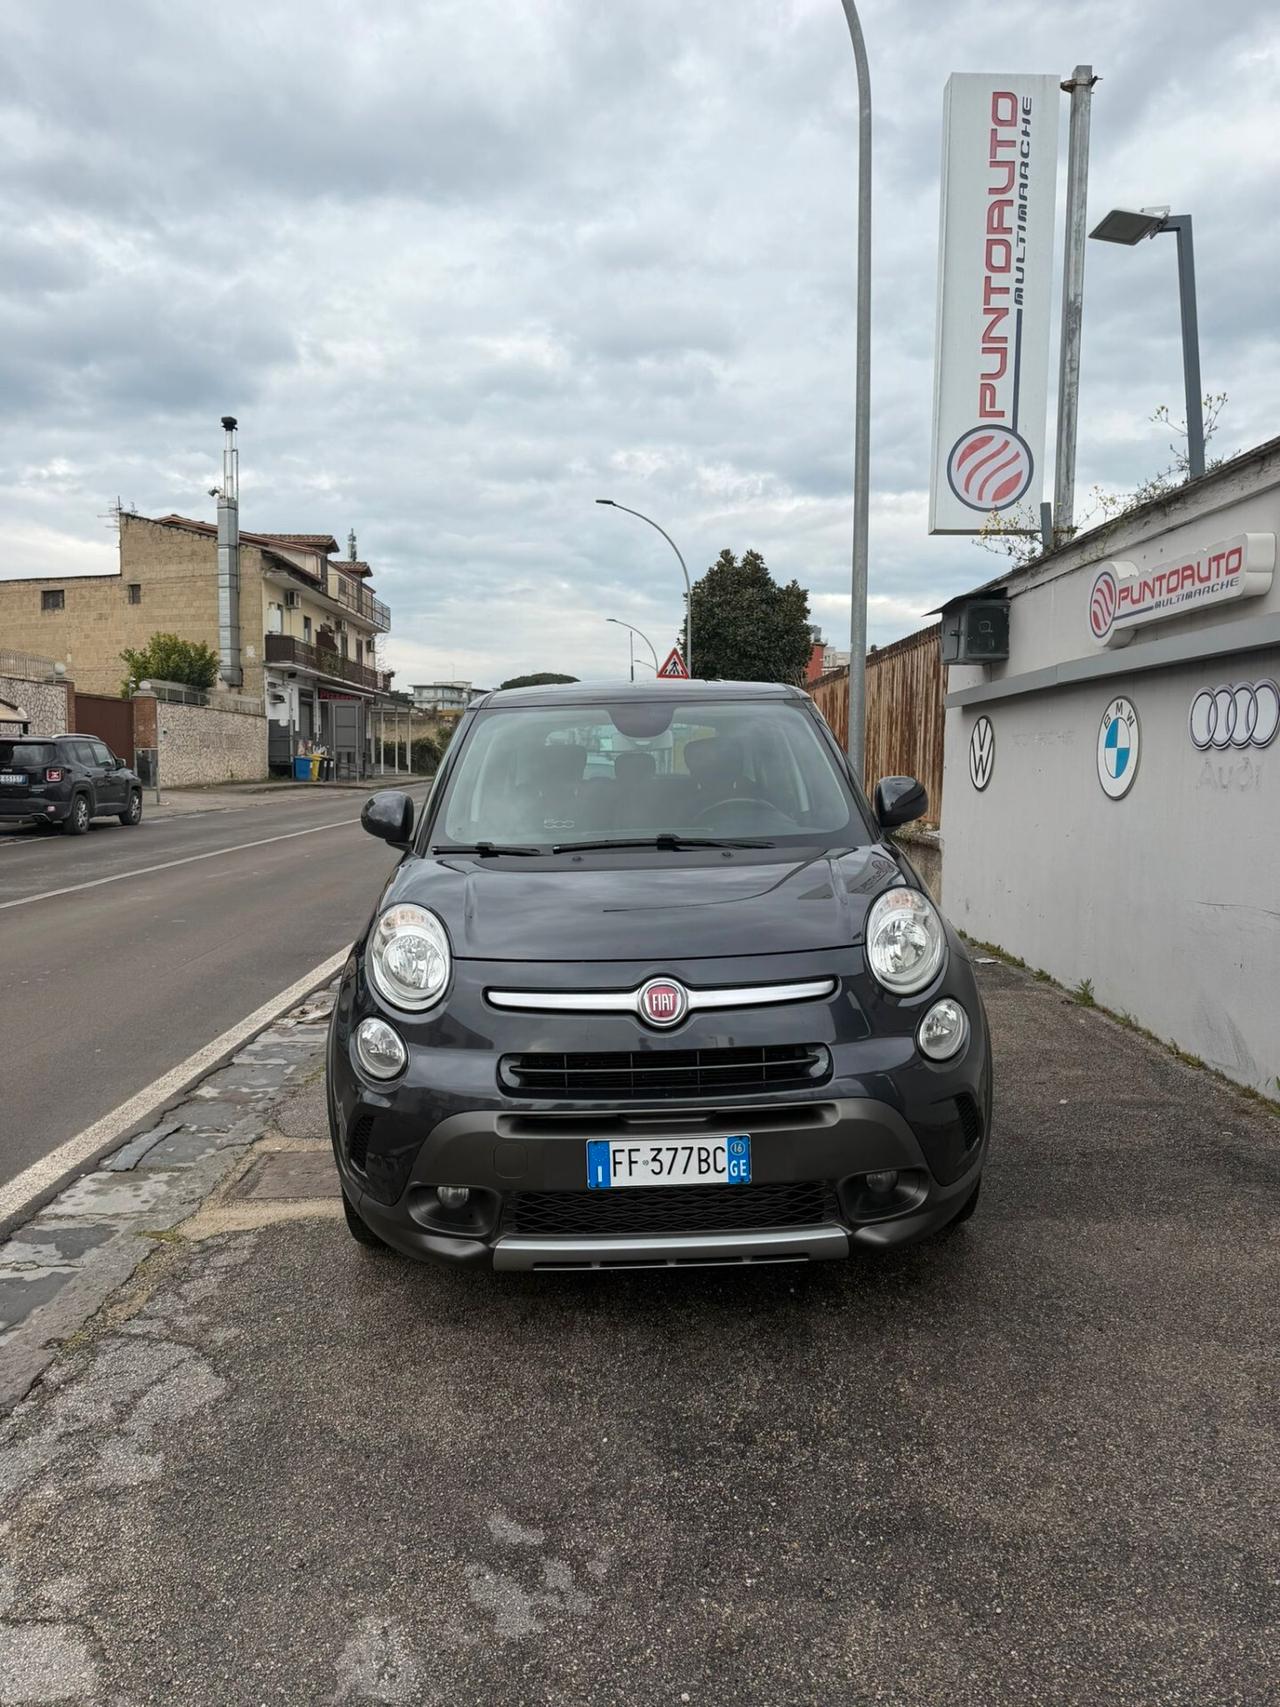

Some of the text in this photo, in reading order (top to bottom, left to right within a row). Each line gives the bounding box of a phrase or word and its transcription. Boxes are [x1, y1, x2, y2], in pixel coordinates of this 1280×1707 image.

[1014, 96, 1032, 305] MULTIMARCHE
[979, 92, 1018, 418] PUNTOAUTO
[1118, 546, 1242, 610] PUNTOAUTO
[1154, 577, 1240, 609] MULTIMARCHE
[1104, 701, 1135, 730] BMW
[652, 993, 675, 1011] FIAT
[733, 1143, 743, 1153] 16
[730, 1159, 747, 1177] GE
